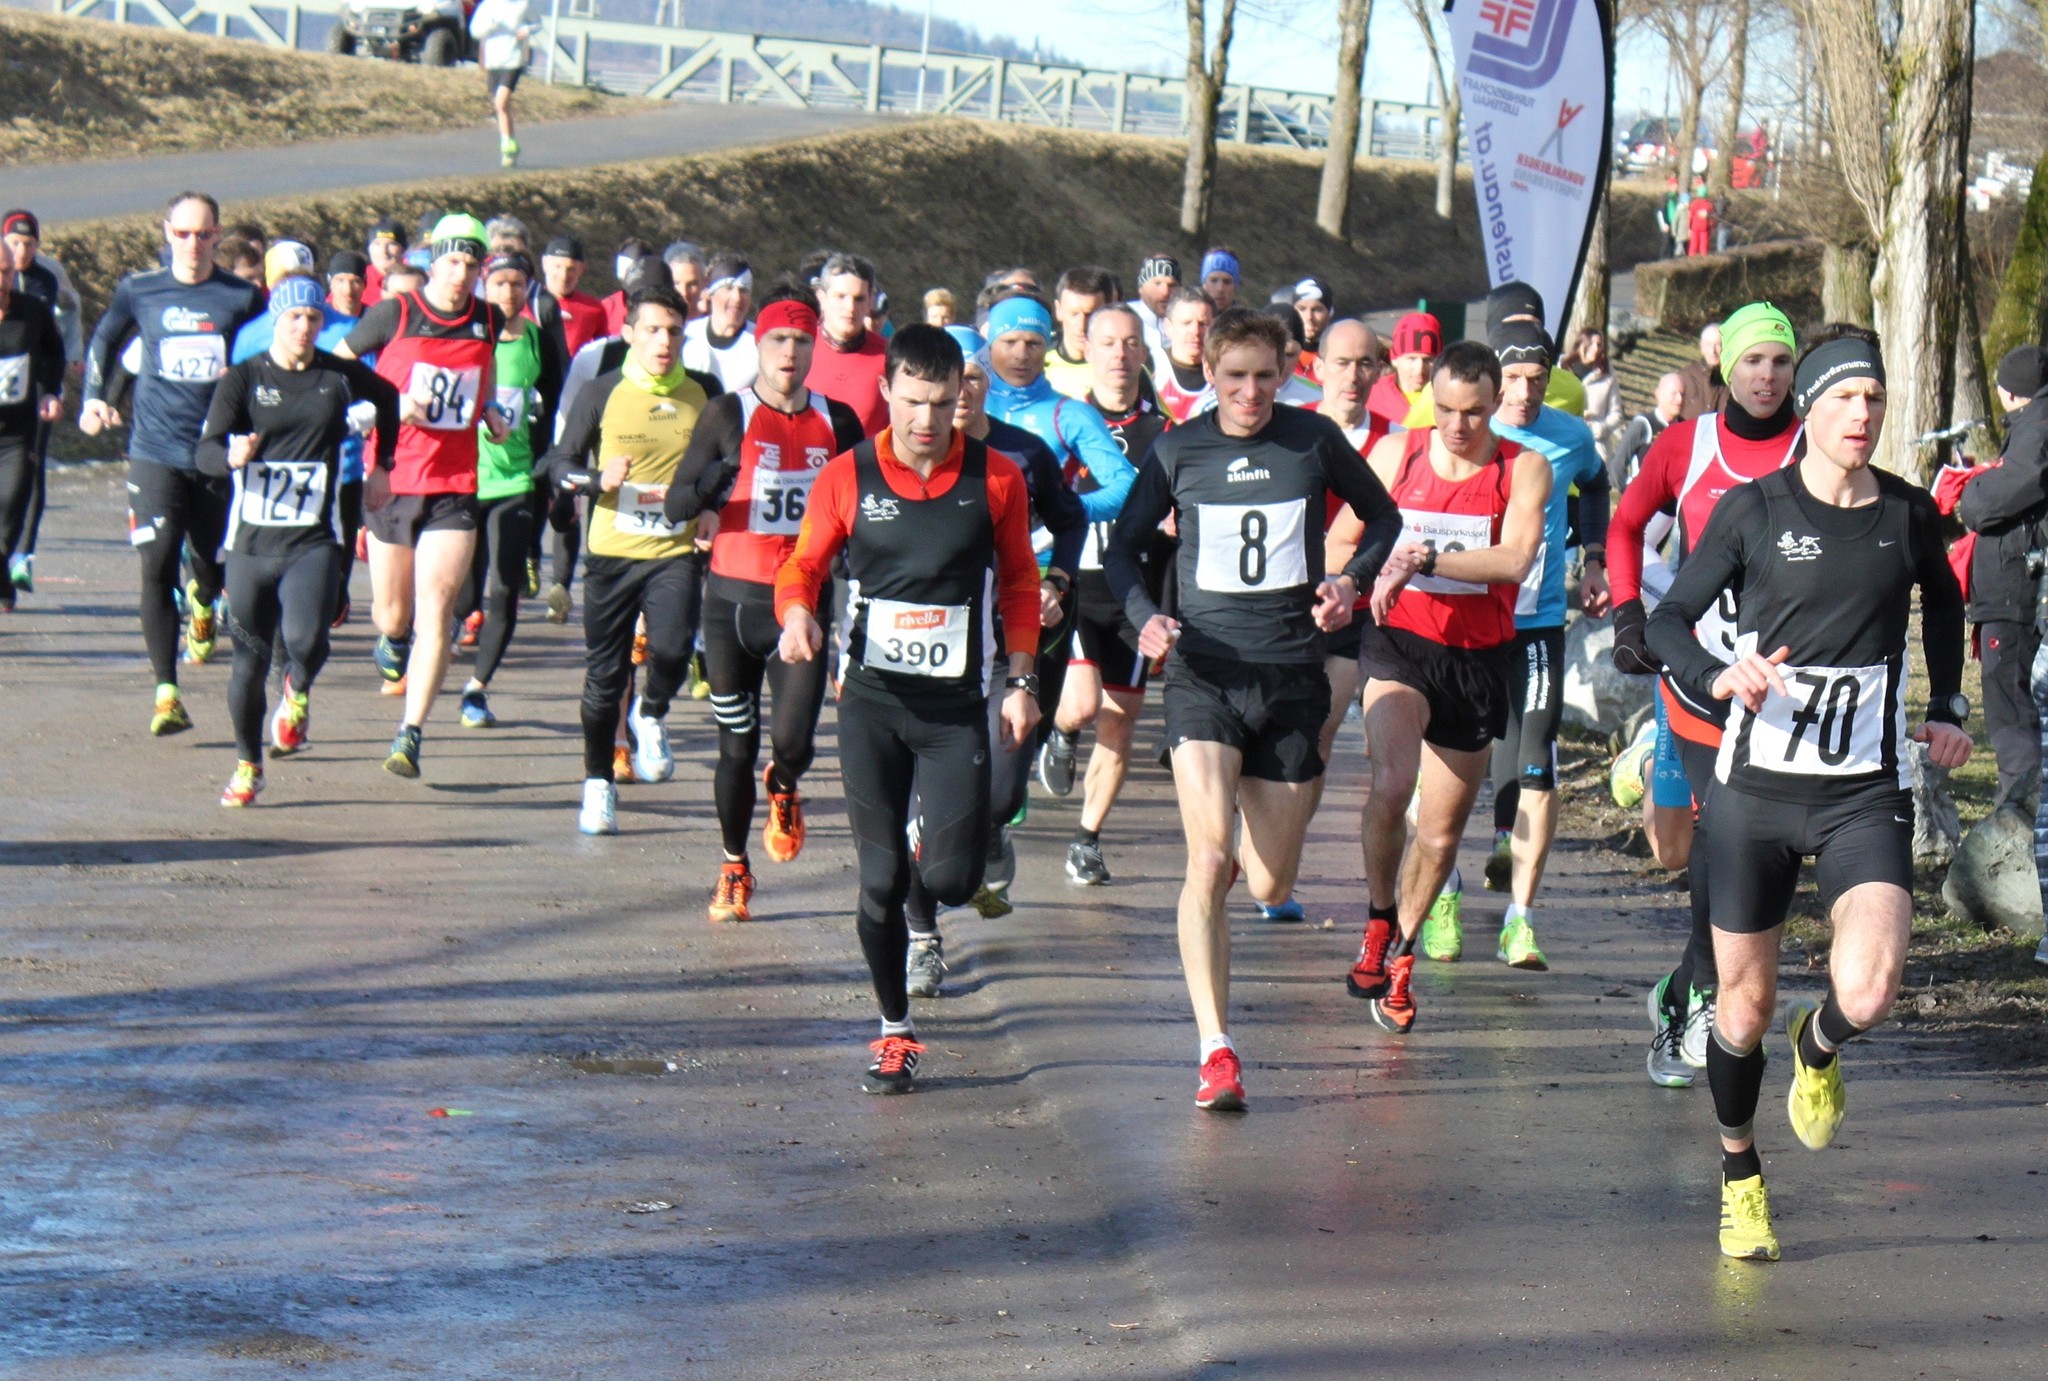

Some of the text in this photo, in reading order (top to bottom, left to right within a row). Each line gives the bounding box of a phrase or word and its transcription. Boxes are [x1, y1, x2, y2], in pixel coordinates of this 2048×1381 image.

[172, 355, 216, 377] 427
[427, 372, 466, 424] 84
[258, 465, 317, 520] 127
[1227, 469, 1270, 483] skinfit
[762, 487, 811, 523] 36
[1240, 508, 1268, 586] 8
[899, 613, 941, 627] rivella
[884, 637, 949, 668] 390
[1783, 671, 1861, 767] 70
